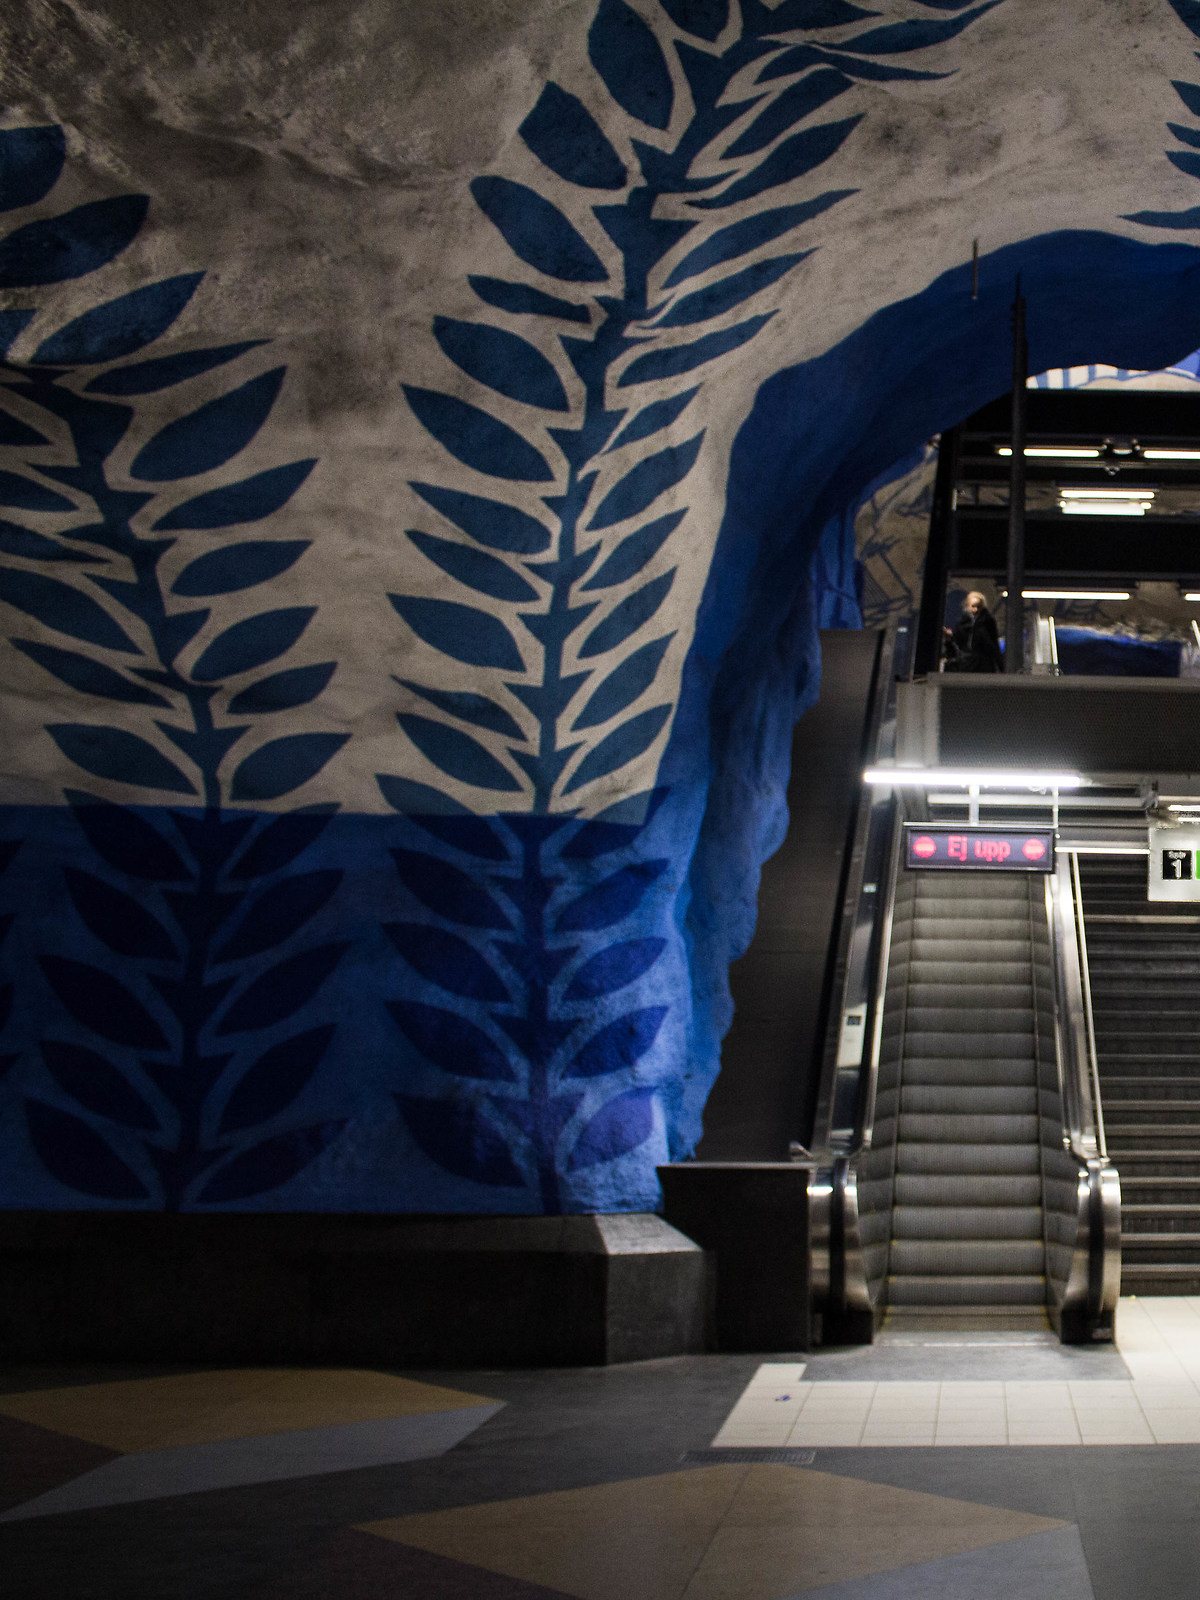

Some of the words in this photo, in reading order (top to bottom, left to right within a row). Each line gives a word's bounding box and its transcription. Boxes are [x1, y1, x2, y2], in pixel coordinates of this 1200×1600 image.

[948, 835, 967, 861] Ej
[974, 841, 1011, 862] upp
[1171, 859, 1181, 878] 1
